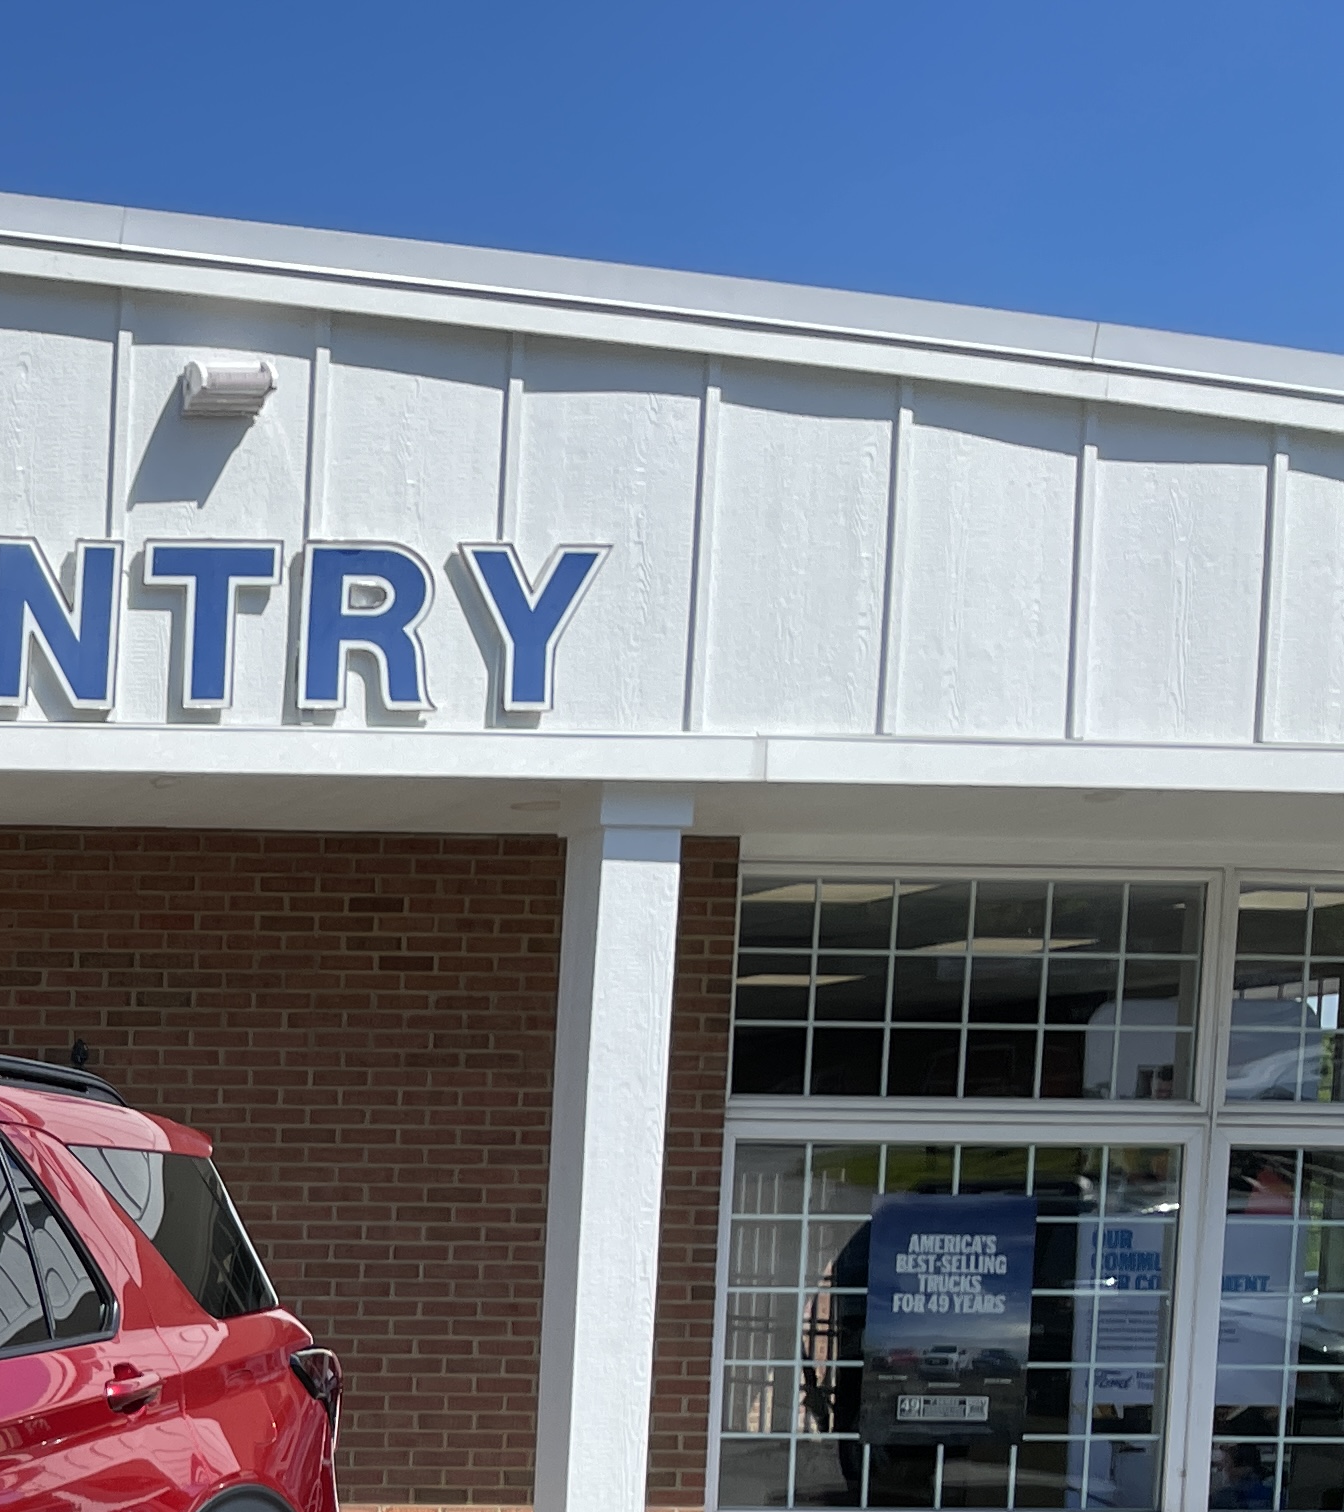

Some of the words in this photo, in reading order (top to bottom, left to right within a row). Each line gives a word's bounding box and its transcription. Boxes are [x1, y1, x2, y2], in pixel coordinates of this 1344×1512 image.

[908, 1234, 997, 1253] AMERICA'S
[896, 1254, 1007, 1274] BEST-SELLING
[917, 1274, 982, 1293] TRUCKS
[892, 1293, 925, 1313] FOR
[927, 1294, 949, 1313] 49
[953, 1294, 1006, 1314] YEARS
